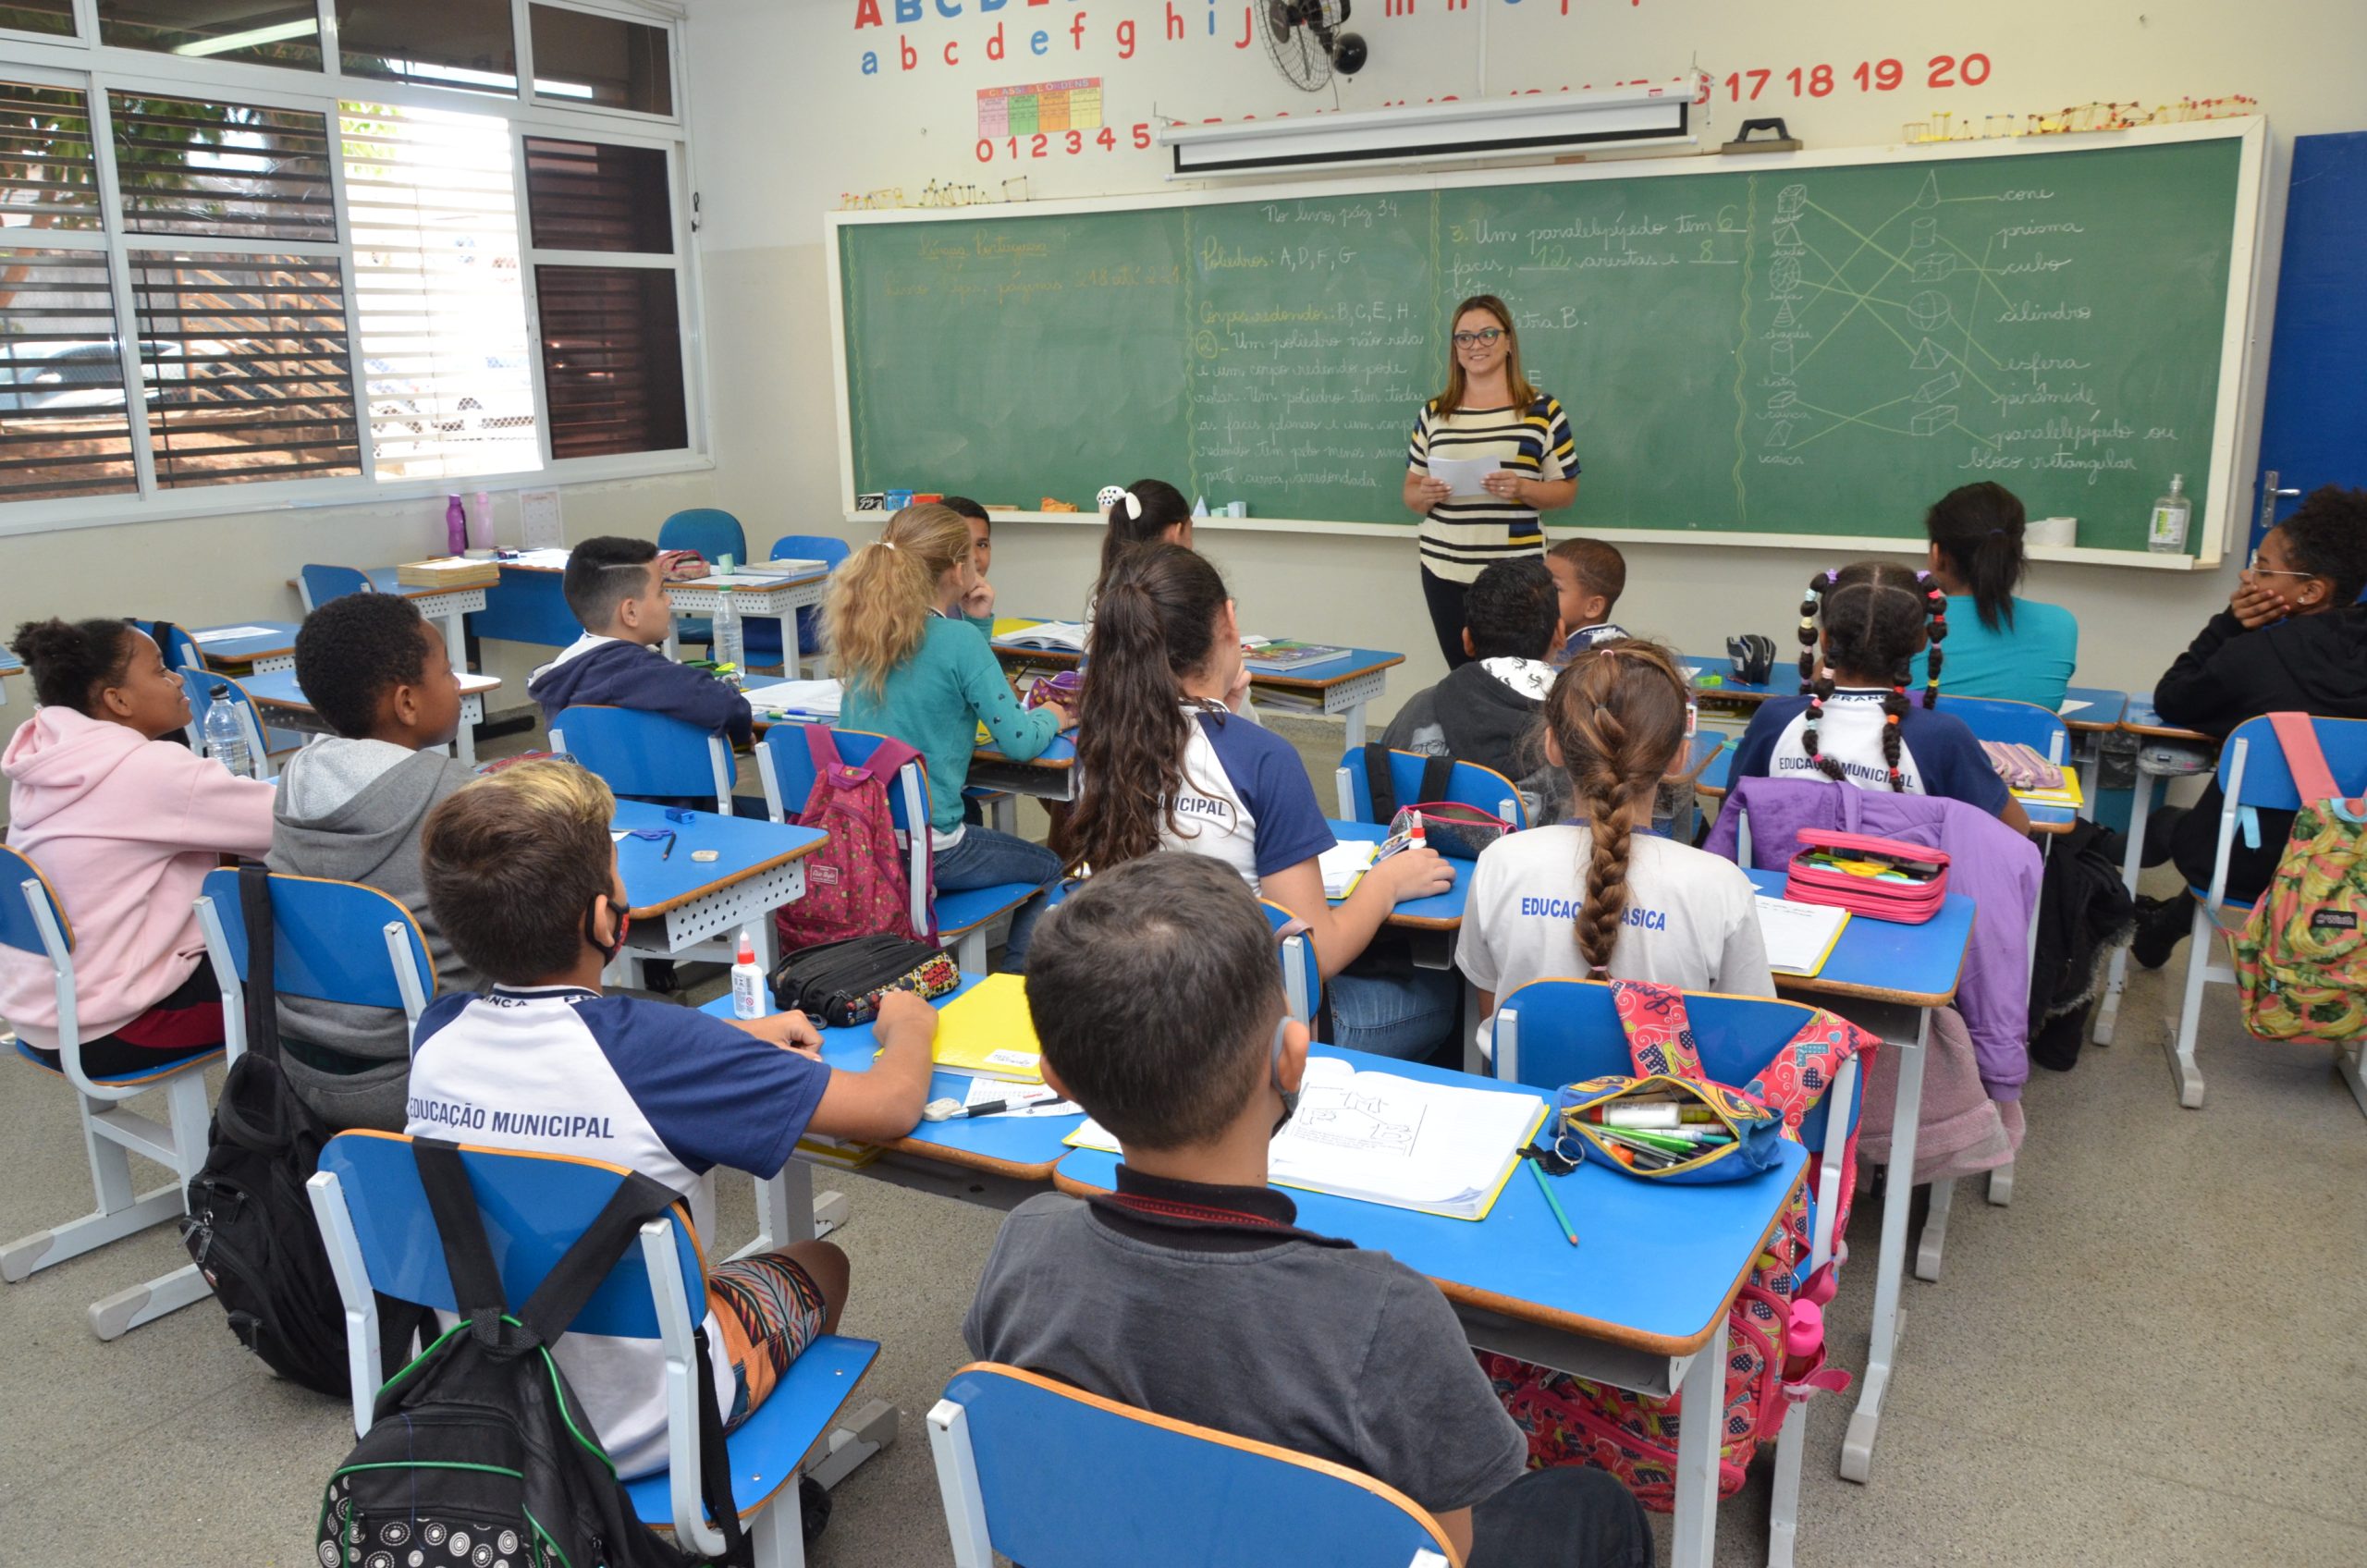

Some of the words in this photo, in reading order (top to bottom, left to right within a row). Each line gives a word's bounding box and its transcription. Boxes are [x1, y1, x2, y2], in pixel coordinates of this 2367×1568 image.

[861, 51, 878, 75] a
[900, 34, 917, 71] b
[943, 42, 959, 66] c
[986, 21, 1005, 61] d
[1030, 30, 1049, 55] e
[1069, 11, 1086, 51] f
[1115, 19, 1135, 59] g
[1166, 2, 1184, 40] h
[1208, 0, 1215, 35] i
[975, 139, 994, 163] 0
[1007, 135, 1018, 160] 1
[1031, 133, 1049, 158] 2
[1065, 129, 1083, 155] 3
[1096, 127, 1117, 153] 4
[1133, 123, 1151, 149] 5
[1725, 69, 1771, 102] 17
[1786, 66, 1834, 97] 18
[1853, 58, 1903, 92] 19
[1927, 53, 1991, 89] 20
[1997, 188, 2054, 202] cone
[1995, 218, 2084, 249] prisma
[1997, 251, 2073, 276] cubo
[1994, 300, 2092, 324] cilindro
[1997, 351, 2091, 385] esfera
[1841, 762, 1914, 788] MUNICIAL
[1620, 902, 1666, 931] ÁSICA
[409, 1096, 485, 1130] EDUCAÇÃO
[491, 1110, 615, 1139] MUNICIPAL
